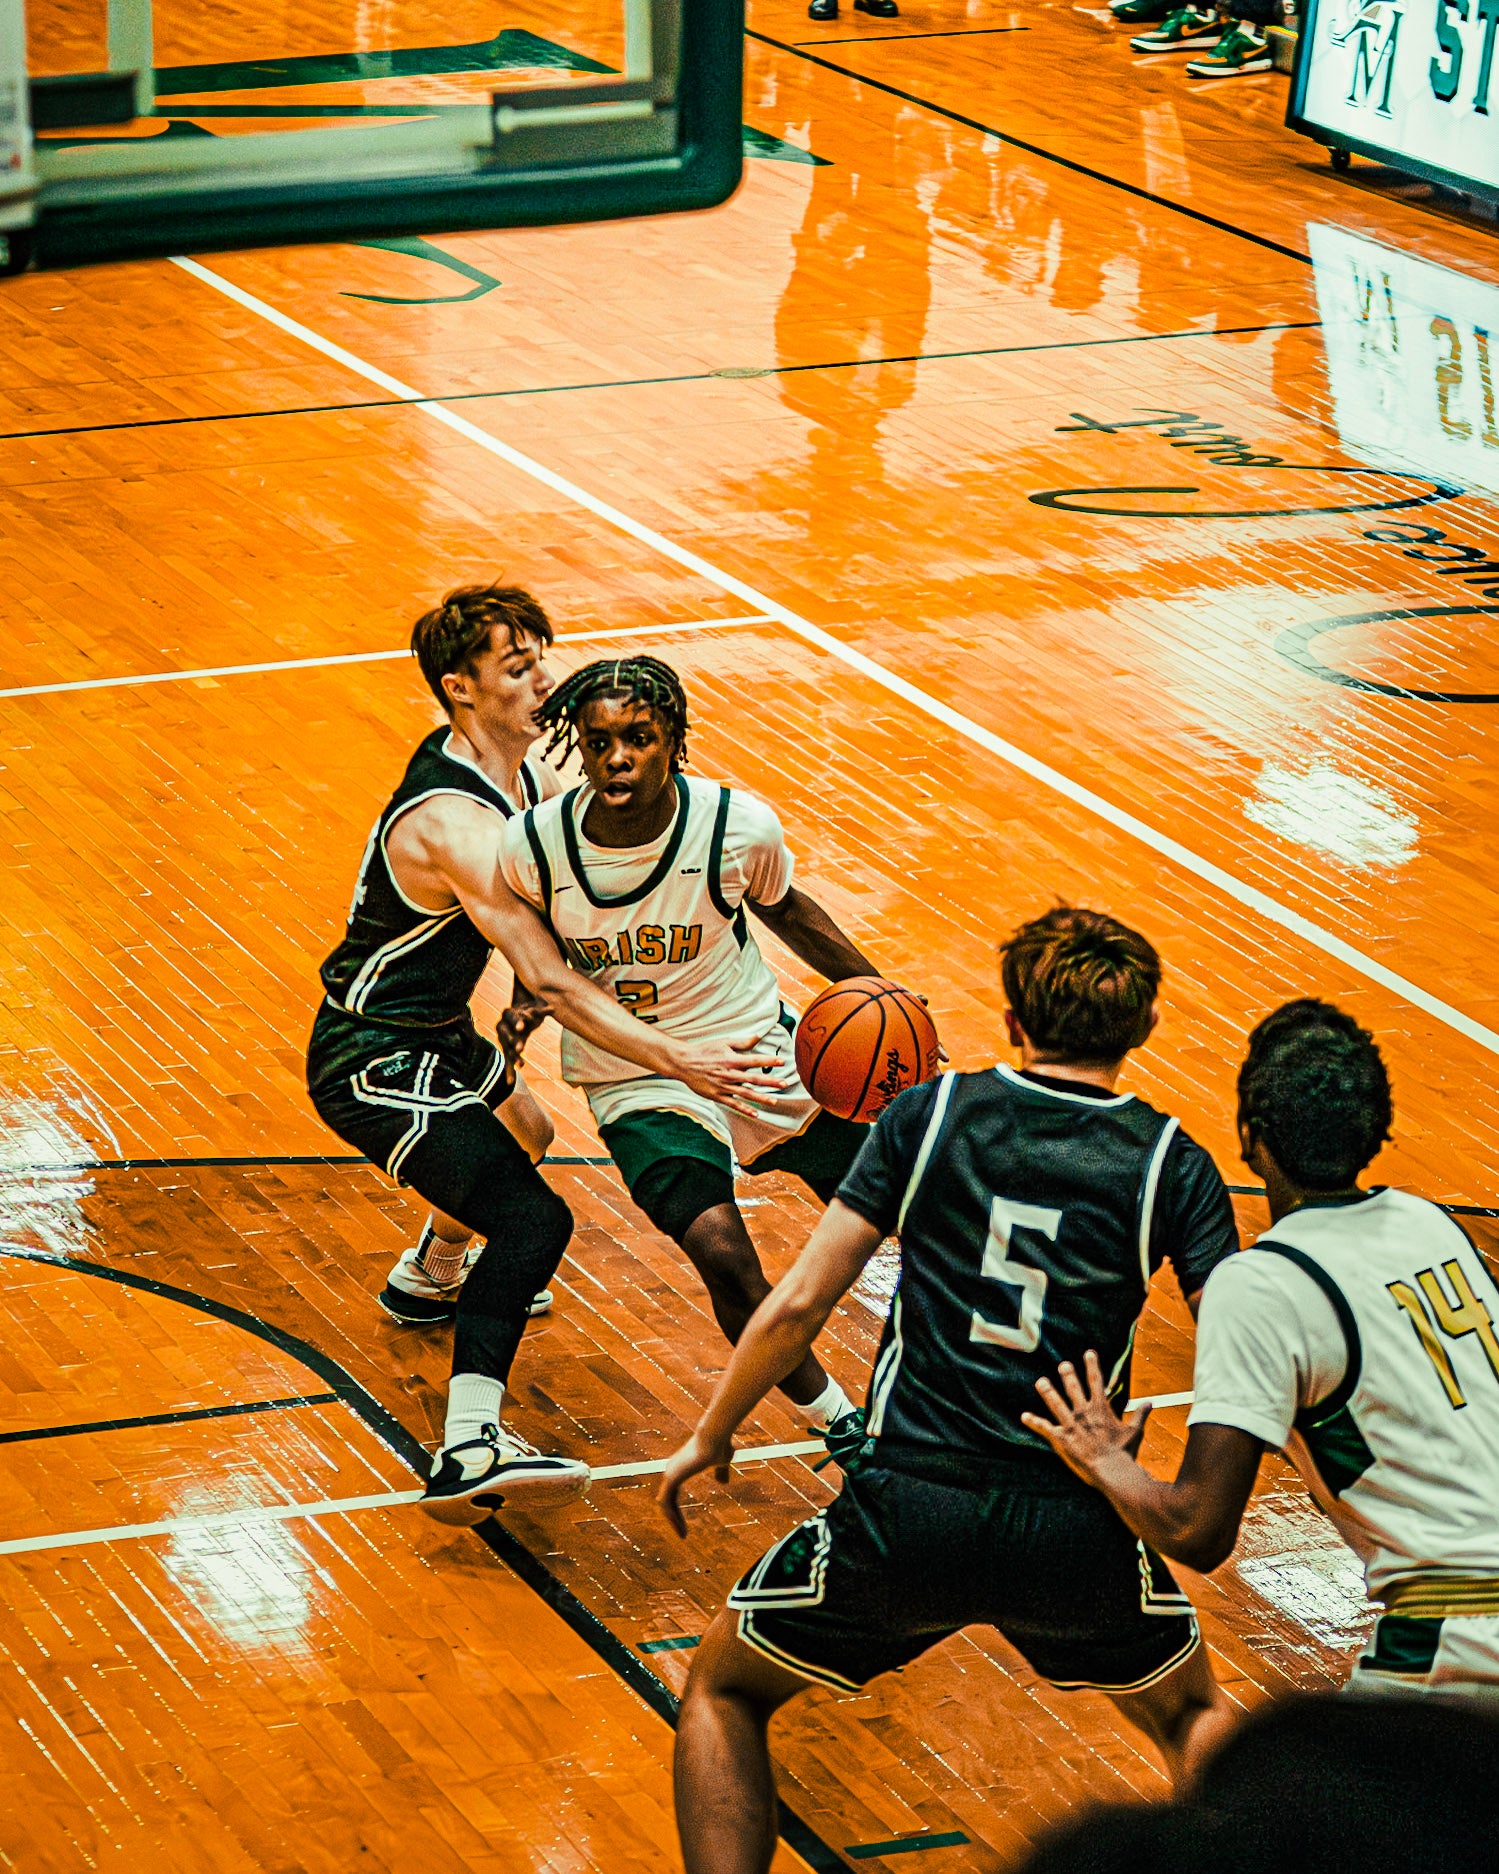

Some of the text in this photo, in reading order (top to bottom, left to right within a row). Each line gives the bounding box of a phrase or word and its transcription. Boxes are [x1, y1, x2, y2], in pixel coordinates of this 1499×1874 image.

[565, 924, 703, 971] IRISH
[615, 979, 659, 1025] 2
[969, 1196, 1062, 1353] 5
[1384, 1257, 1499, 1411] 14
